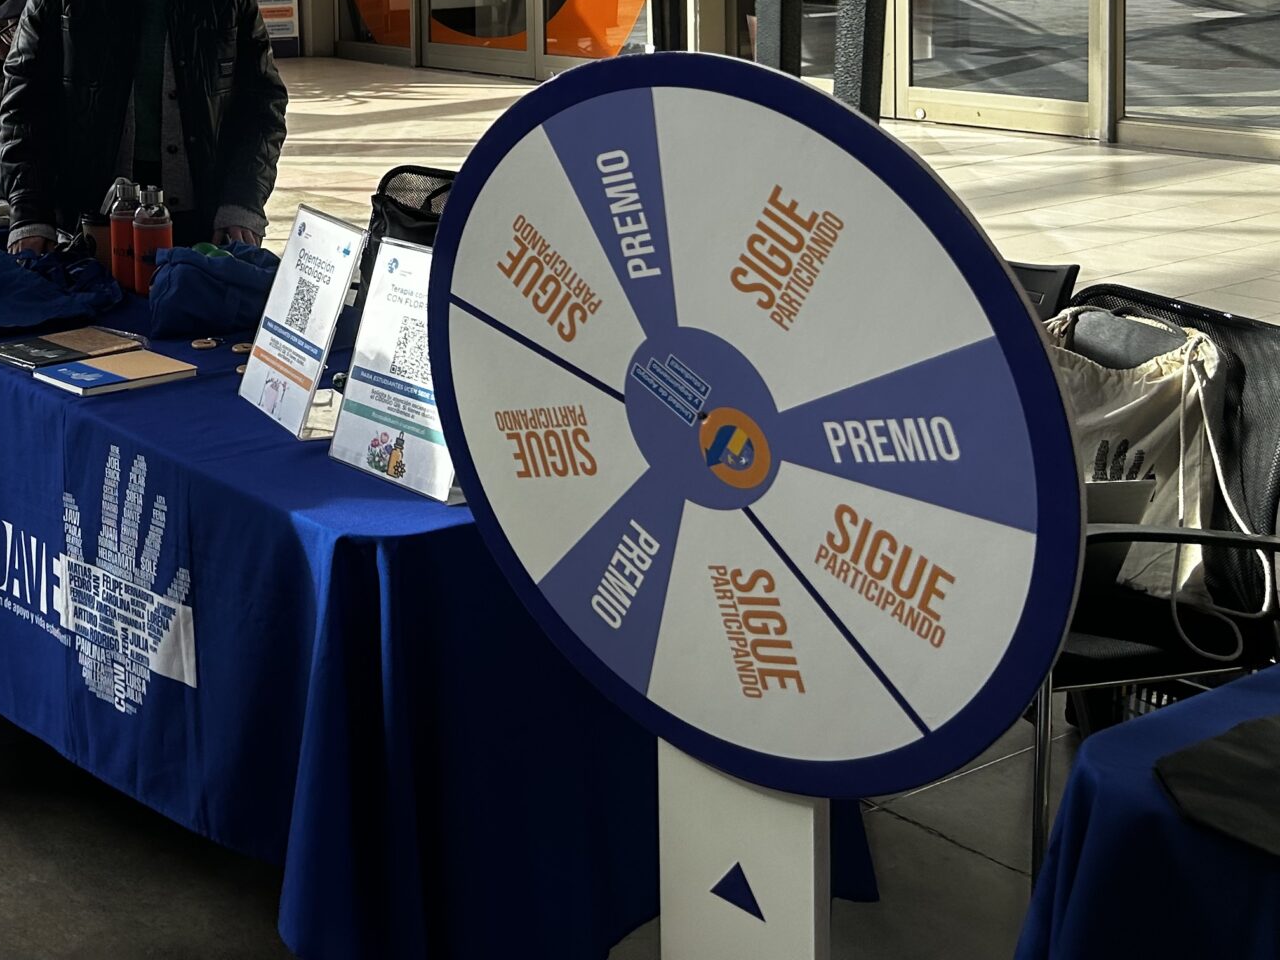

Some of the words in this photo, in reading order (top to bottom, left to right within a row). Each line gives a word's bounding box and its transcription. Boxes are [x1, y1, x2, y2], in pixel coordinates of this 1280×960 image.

[596, 149, 662, 279] PREMIO
[730, 184, 820, 310] SIGUE
[512, 214, 603, 315] PARTICIPANDO
[770, 210, 845, 331] PARTICIPANDO
[386, 293, 402, 304] CON
[391, 283, 414, 297] Terapia
[496, 235, 588, 343] SIGUE
[636, 368, 657, 389] Apoyo
[652, 363, 693, 400] Seguimiento
[495, 405, 588, 431] PARTICIPANDO
[667, 396, 692, 419] Unidad
[506, 428, 598, 478] SIGUE
[823, 416, 961, 464] PREMIO
[106, 457, 121, 471] JOEL
[126, 489, 143, 506] SOFIA
[67, 560, 92, 580] MATIAS
[140, 557, 157, 577] SOLE
[591, 519, 661, 630] PREMIO
[826, 503, 956, 622] SIGUE
[69, 573, 92, 593] PEDRO
[102, 573, 124, 597] FELIPE
[102, 589, 130, 613] CAROLINA
[814, 544, 946, 649] PARTICIPANDO
[4, 597, 12, 610] de
[12, 602, 30, 620] apoyo
[35, 614, 46, 629] vida
[73, 606, 98, 628] ARTURO
[147, 609, 170, 632] LORENA
[89, 626, 120, 652] RODRIGO
[129, 631, 149, 654] JULIA
[708, 565, 763, 699] PARTICIPANDO
[730, 569, 806, 694] SIGUE
[75, 635, 106, 664] PAULINA
[126, 658, 150, 683] CLAUDIA
[126, 671, 147, 695] LUISA
[113, 662, 126, 713] CONI
